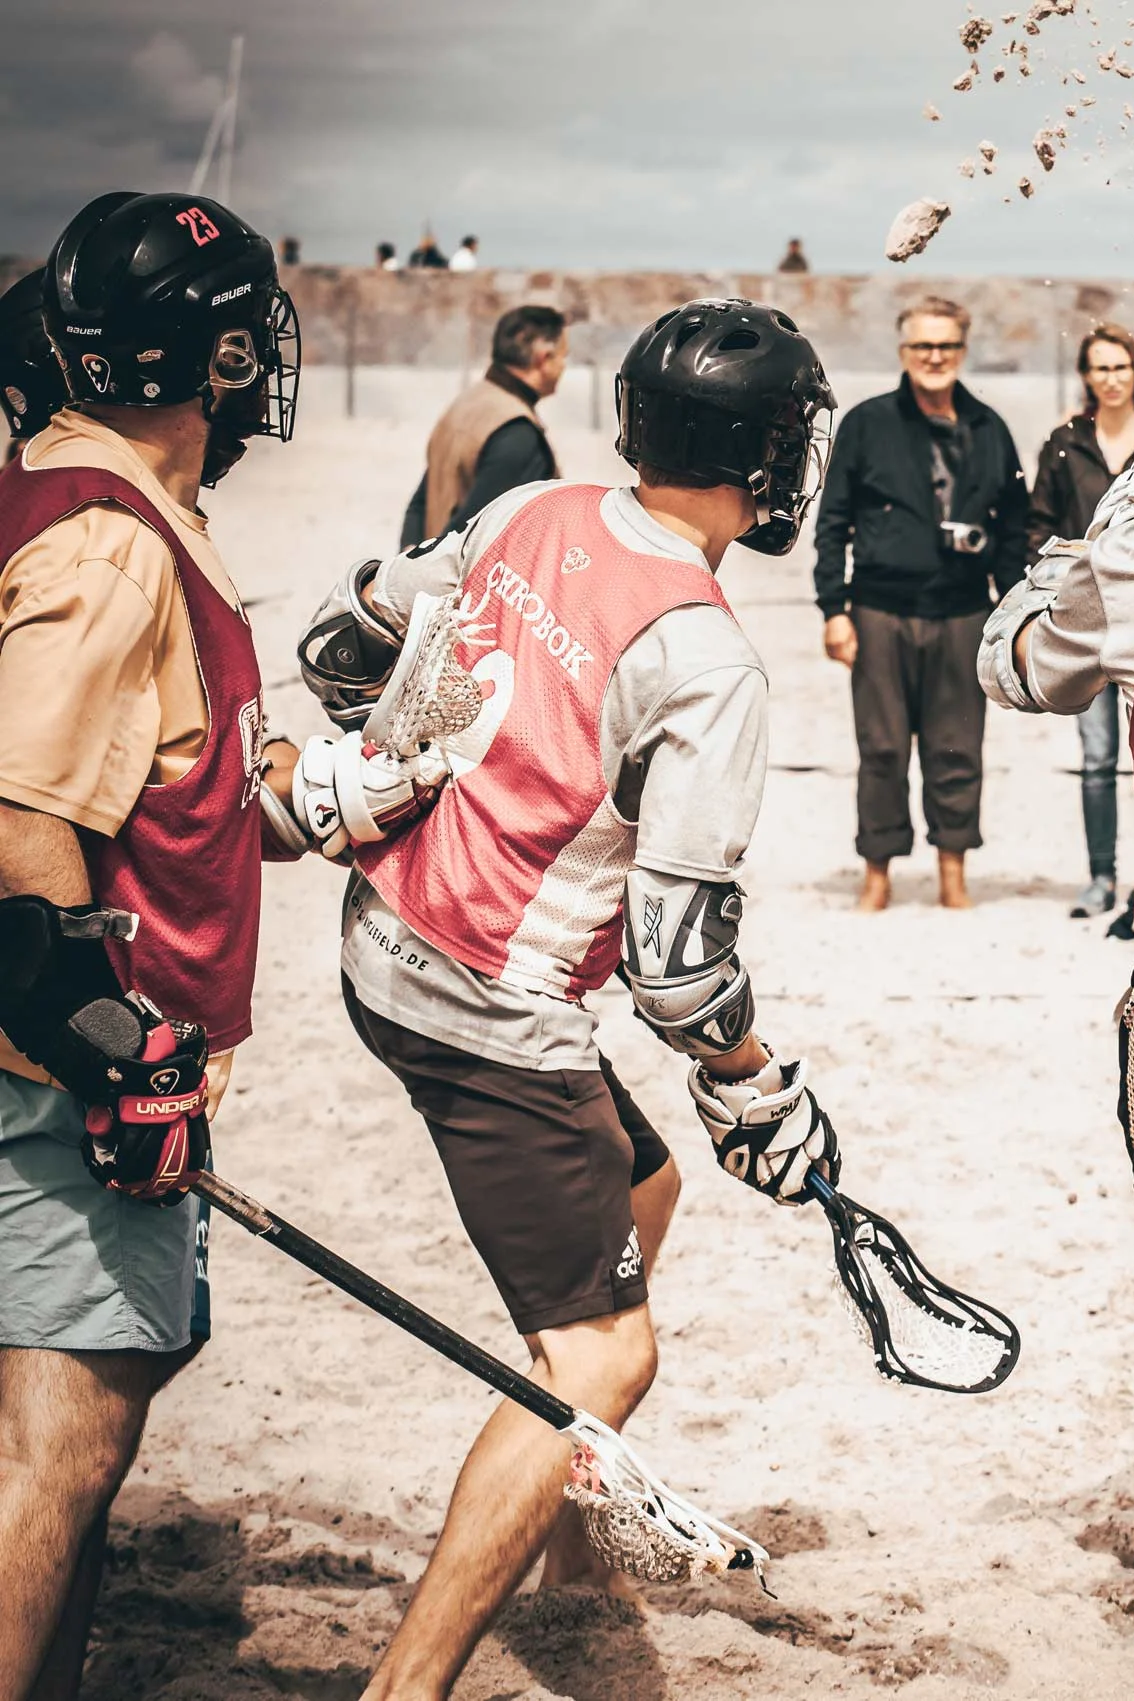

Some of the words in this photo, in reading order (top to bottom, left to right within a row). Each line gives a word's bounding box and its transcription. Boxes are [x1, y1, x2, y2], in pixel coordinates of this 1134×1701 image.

[175, 207, 220, 247] 23
[211, 282, 252, 307] BAUER
[66, 325, 102, 336] BAUER
[487, 560, 595, 681] CHROBOK
[136, 1094, 200, 1116] UNDER
